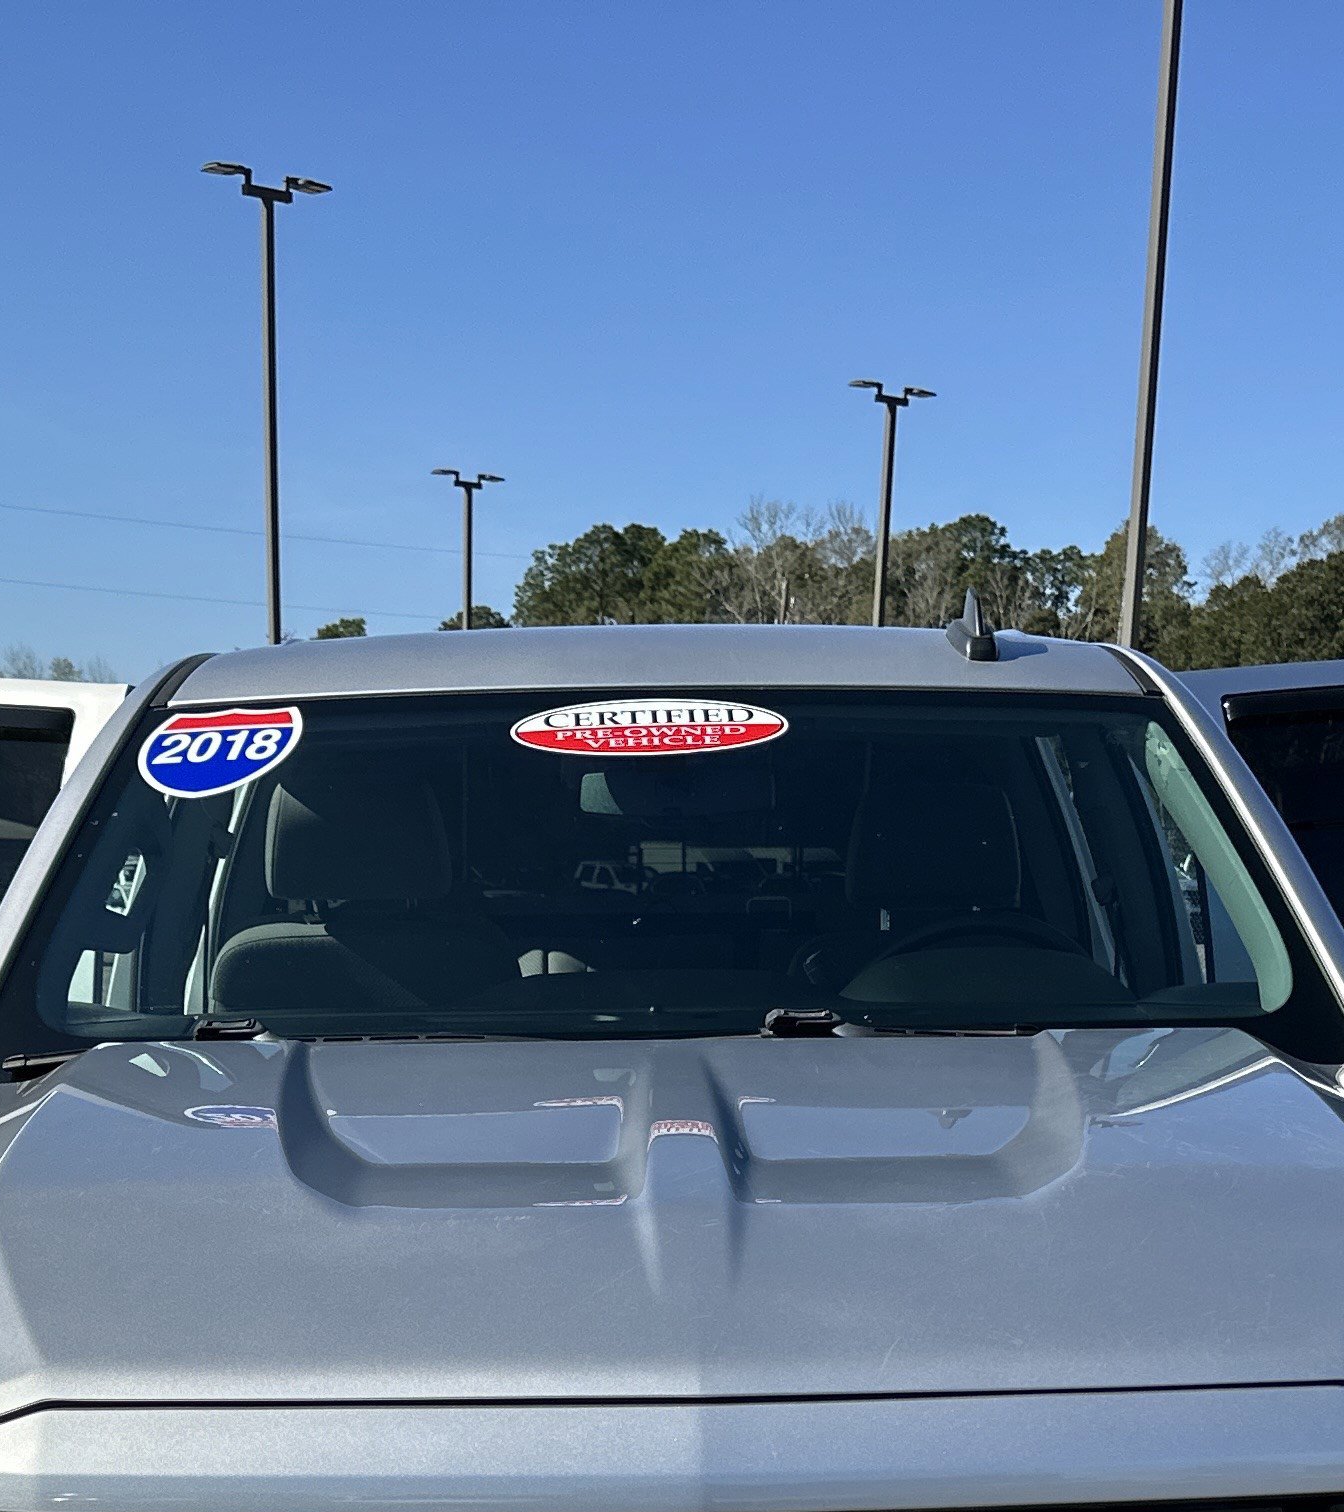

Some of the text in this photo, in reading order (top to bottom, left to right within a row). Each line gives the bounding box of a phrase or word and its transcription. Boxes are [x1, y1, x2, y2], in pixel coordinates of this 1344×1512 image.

[543, 708, 754, 728] CERTIFIED
[555, 725, 747, 741] PRE-OWNED
[583, 735, 722, 749] VEHICLE
[151, 728, 282, 765] 2018
